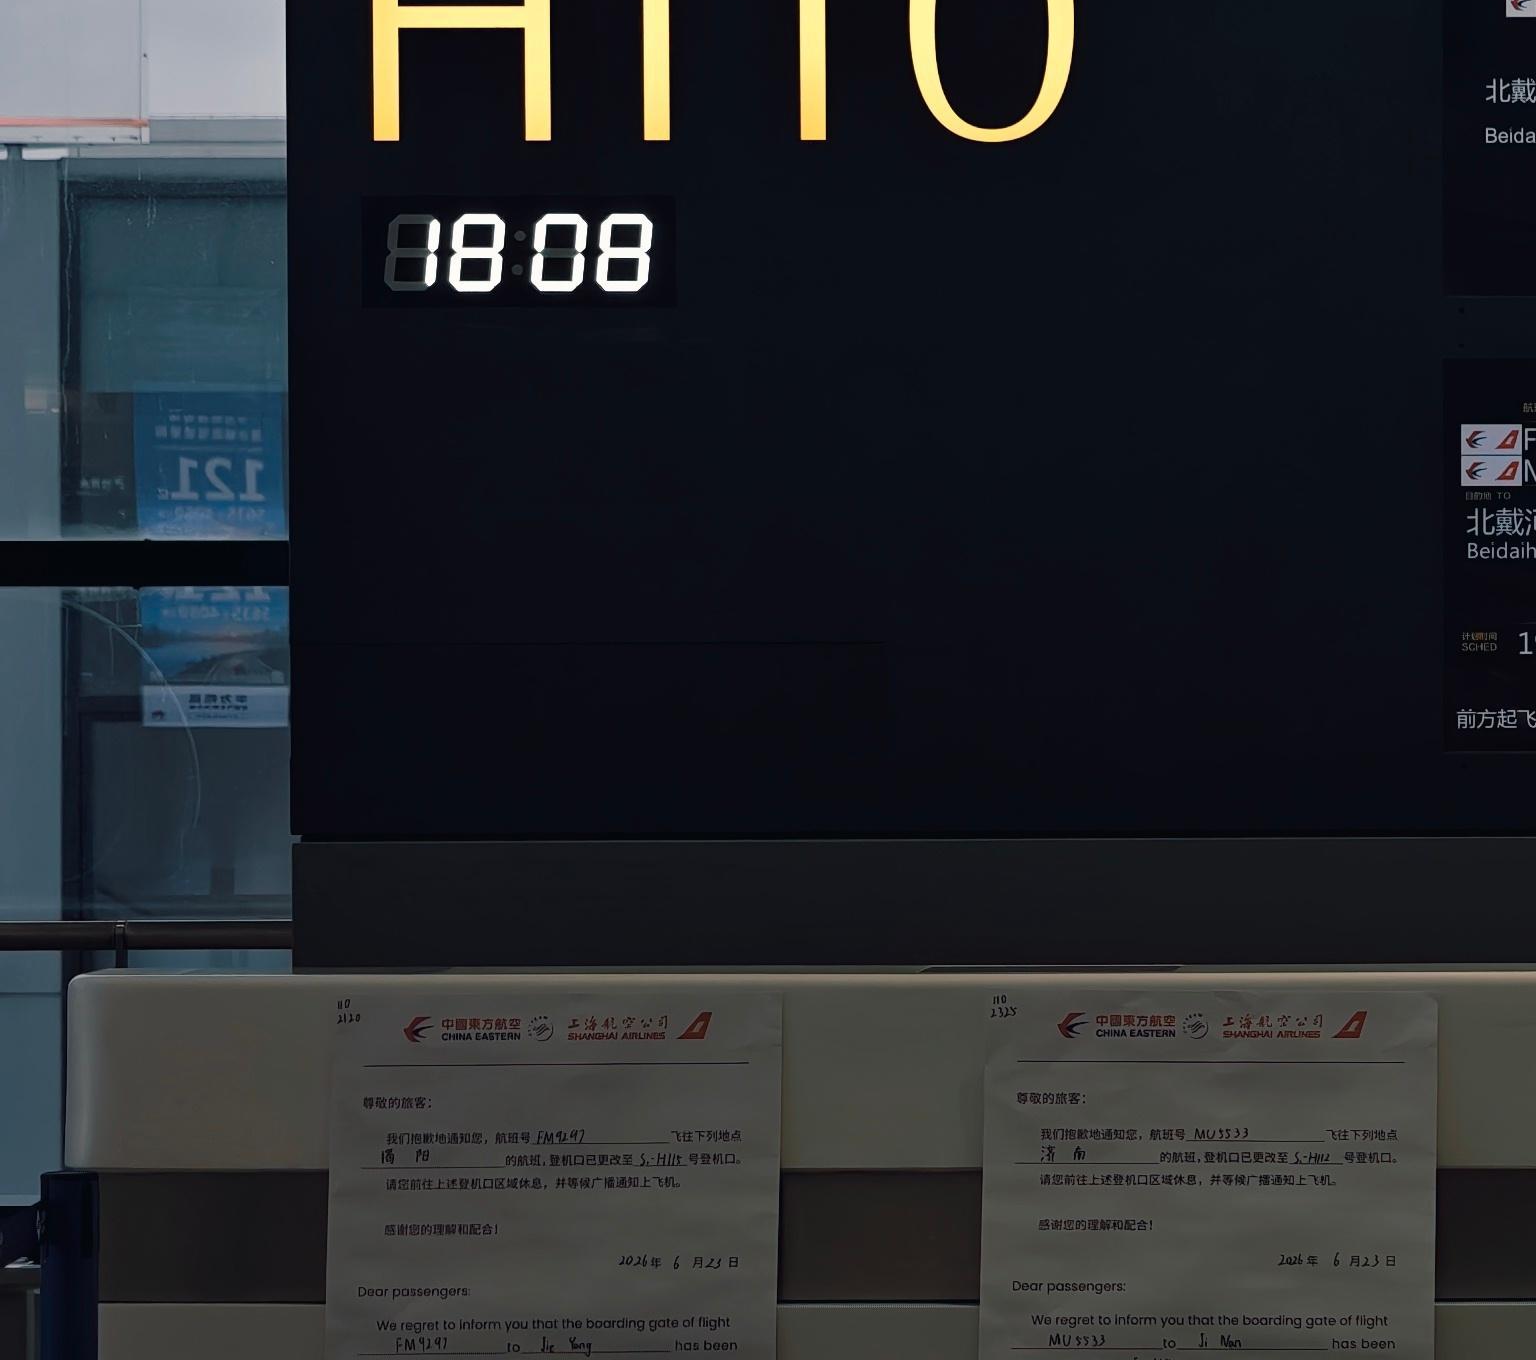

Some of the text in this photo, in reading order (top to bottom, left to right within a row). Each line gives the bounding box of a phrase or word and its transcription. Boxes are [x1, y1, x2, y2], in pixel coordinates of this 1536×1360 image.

[1498, 492, 1511, 500] TO
[1462, 642, 1497, 651] SCHED
[1457, 709, 1536, 728] 前方起飞
[442, 1018, 520, 1030] 中國東方航空
[1096, 1015, 1175, 1027] 中國東方航空
[476, 1032, 520, 1040] EASTERN
[568, 1032, 665, 1040] SHANGHAI AIRLINES
[1096, 1029, 1175, 1037] CHINA EASTERN
[1223, 1031, 1272, 1040] SHANGHAI
[359, 1287, 470, 1300] Dear passengers:
[1013, 1281, 1125, 1295] Dear passengers:
[377, 1317, 730, 1334] We regret to inform you that the boarding gate of flight
[1032, 1314, 1387, 1329] We regret to inform you that the boarding gate of flight
[508, 1340, 737, 1352] to has been
[1162, 1339, 1395, 1349] to has been
